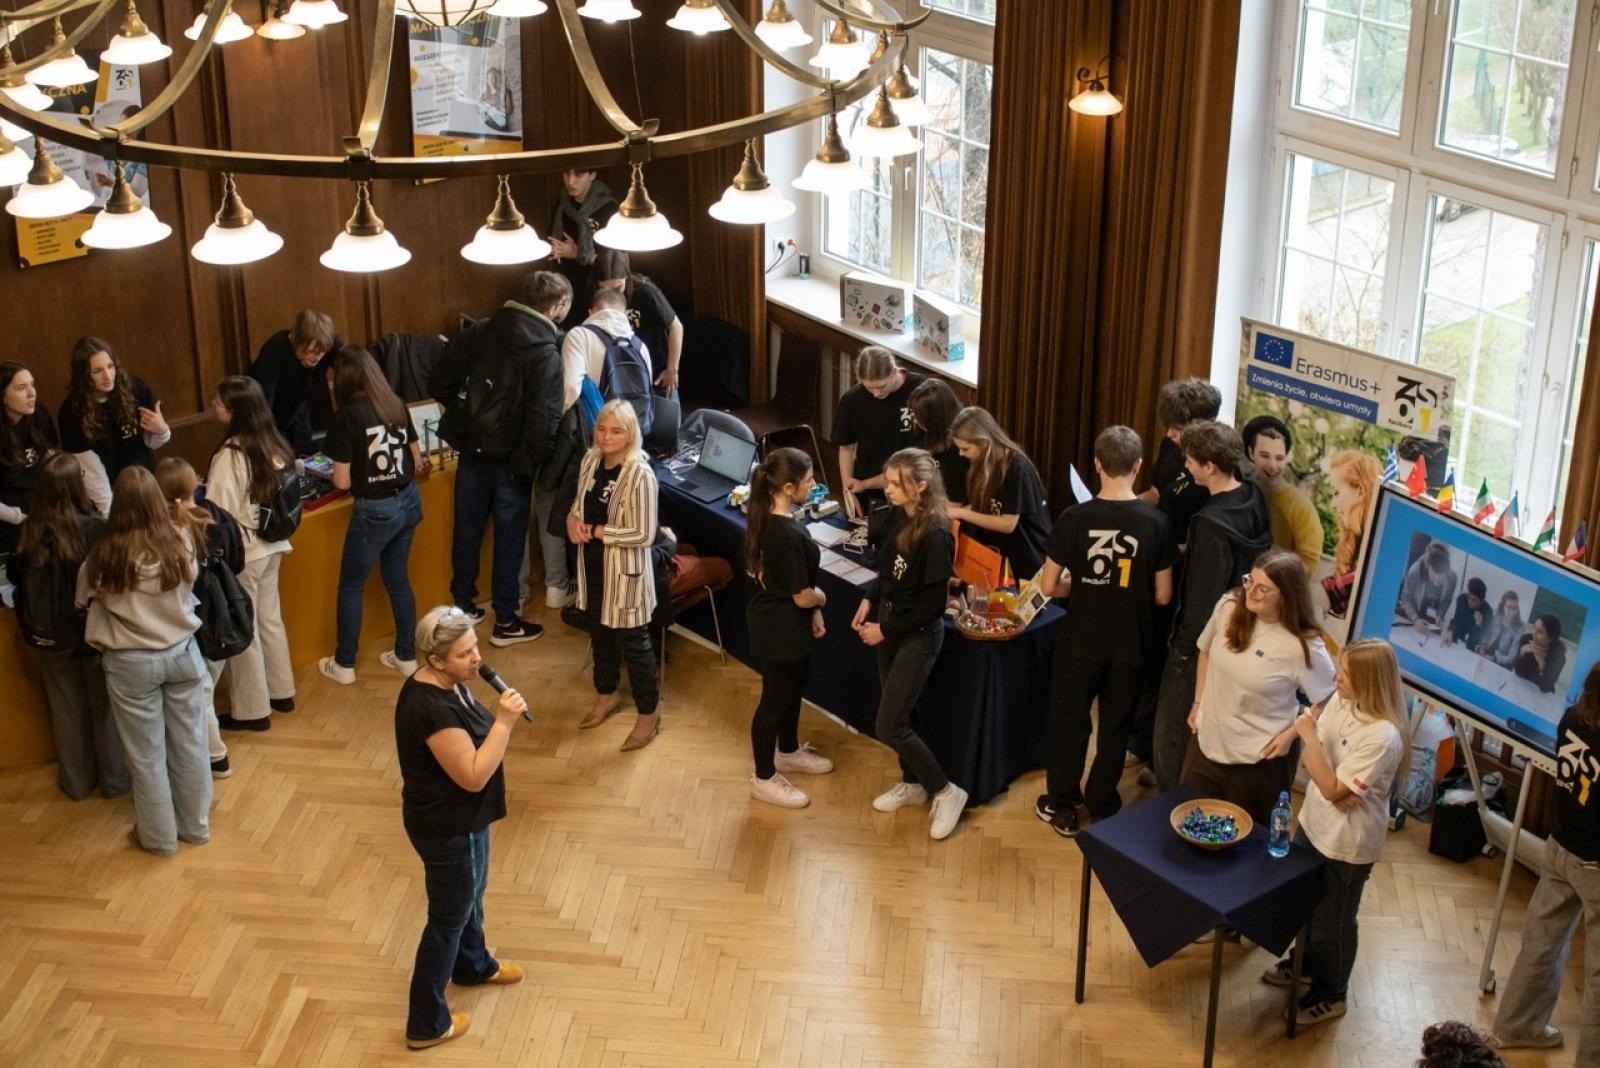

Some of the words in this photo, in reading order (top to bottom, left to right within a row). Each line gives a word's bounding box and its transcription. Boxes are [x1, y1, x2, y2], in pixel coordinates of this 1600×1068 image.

[1252, 373, 1284, 390] Zmienia
[1284, 383, 1308, 398] życie,
[1309, 390, 1341, 407] otwiera
[1343, 401, 1372, 417] umysły
[1295, 357, 1382, 395] Erasmus+
